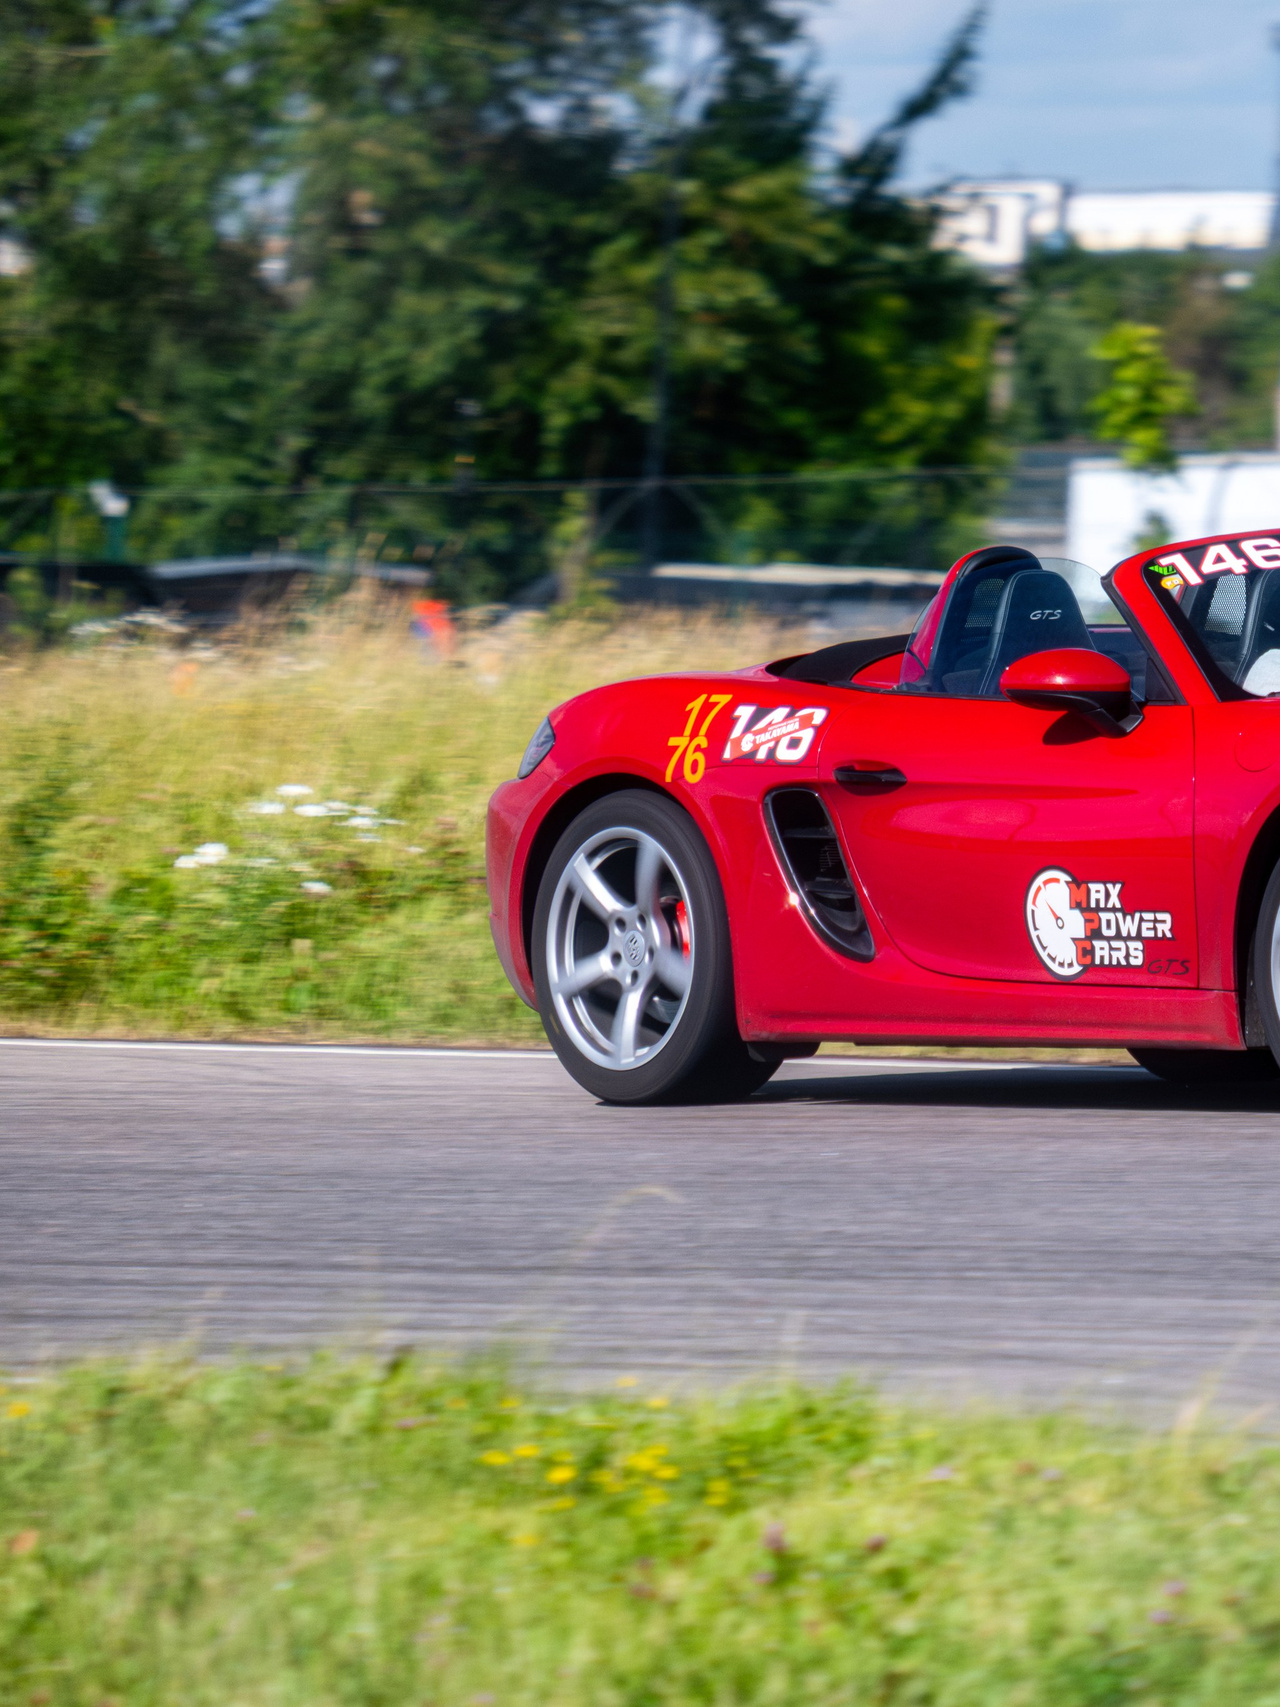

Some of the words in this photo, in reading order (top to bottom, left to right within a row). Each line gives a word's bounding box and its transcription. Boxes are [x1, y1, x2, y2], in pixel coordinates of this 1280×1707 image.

[1030, 609, 1062, 620] GTS
[685, 694, 733, 736] 17
[755, 722, 800, 744] TAKAYAMA
[665, 736, 708, 784] 76
[1069, 882, 1122, 908] MAX
[1082, 911, 1173, 938] POWER
[1075, 940, 1144, 966] CARS
[1147, 959, 1190, 976] GTS
